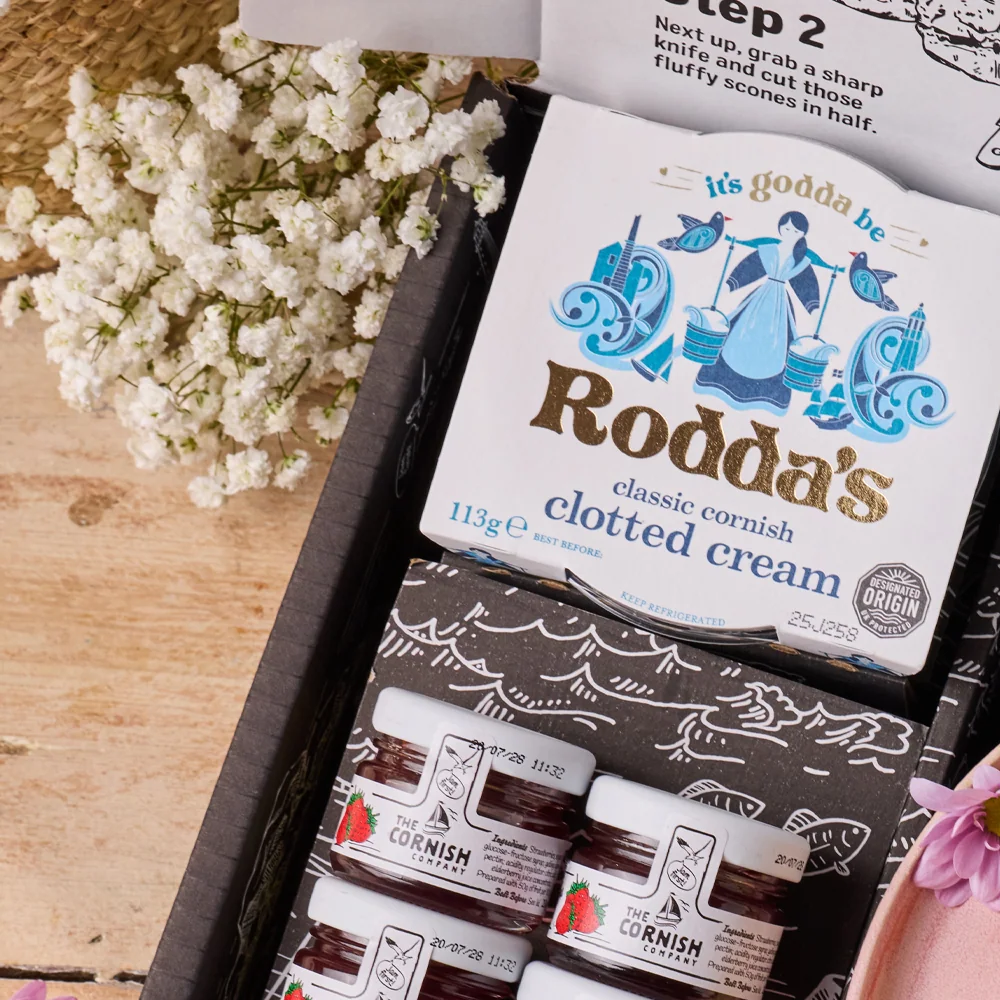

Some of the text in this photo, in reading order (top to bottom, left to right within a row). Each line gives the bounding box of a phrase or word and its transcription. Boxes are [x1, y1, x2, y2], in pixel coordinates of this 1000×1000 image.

[799, 14, 825, 49] 2
[655, 34, 863, 110] knife and cut those
[656, 15, 884, 98] Next up, grab a sharp
[654, 54, 877, 134] fluffy scones in half.
[705, 170, 886, 242] it's godda be
[529, 359, 894, 524] Rodda's
[612, 477, 794, 543] classic cornish
[533, 532, 604, 560] BEST BEFORE:
[544, 489, 842, 599] clotted cream
[862, 586, 920, 619] ORIGIN
[869, 576, 921, 600] DESIGNATED
[620, 590, 726, 627] KEEP REFRIGERATED
[868, 619, 912, 634] PROTECTED
[531, 759, 566, 780] 11:32
[396, 815, 419, 831] THE
[389, 827, 471, 867] CORNISH
[411, 854, 467, 876] COMPANY
[677, 866, 691, 879] Jam
[626, 906, 650, 923] THE
[429, 937, 517, 973] 20/07/28 11:32
[619, 918, 703, 958] CORNISH
[643, 944, 698, 967] COMPANY
